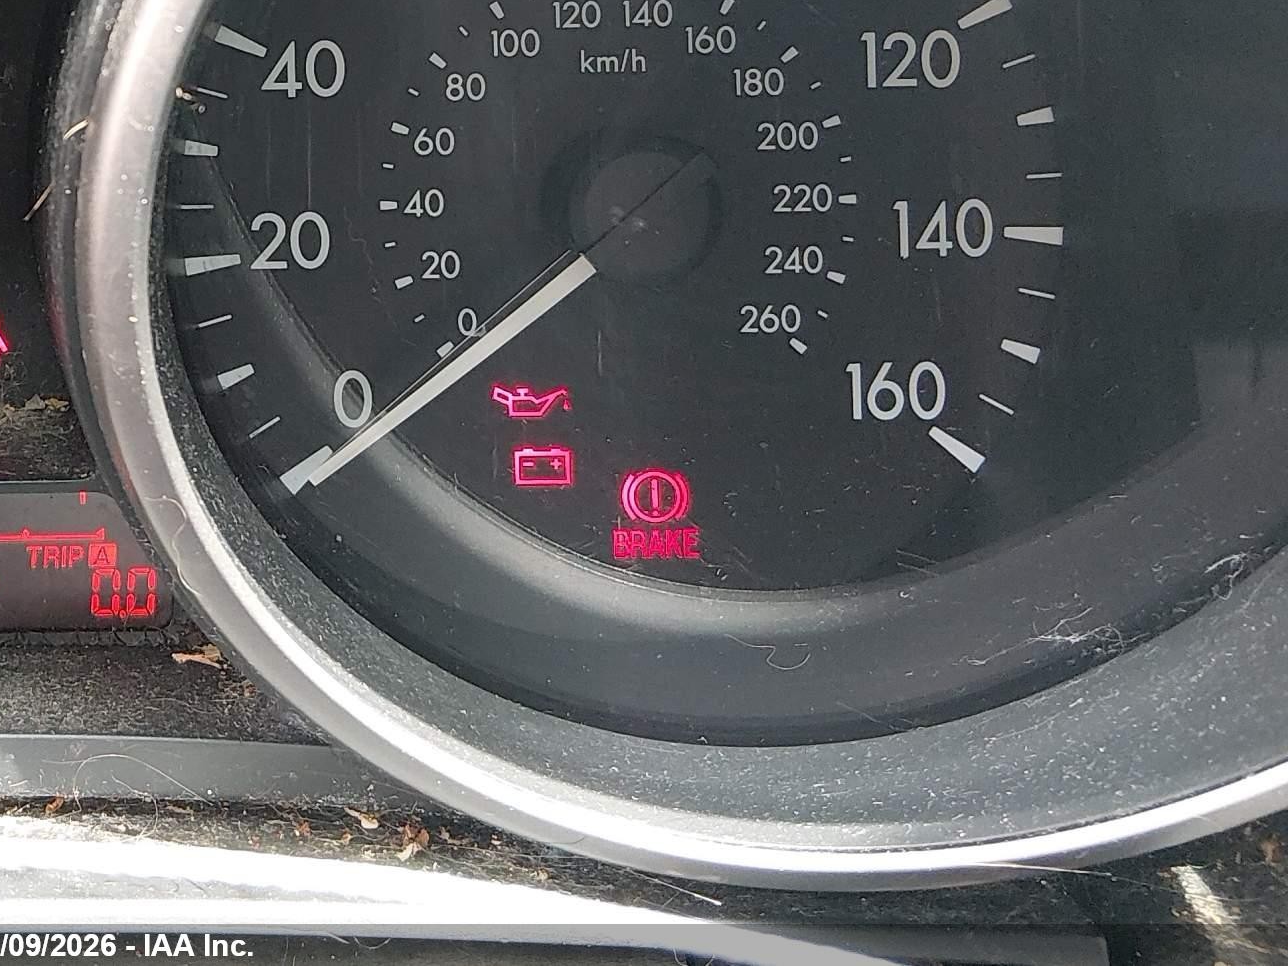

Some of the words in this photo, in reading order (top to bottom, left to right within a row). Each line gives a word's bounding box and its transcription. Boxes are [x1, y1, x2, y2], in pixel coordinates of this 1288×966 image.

[553, 1, 601, 29] 120
[623, 0, 673, 27] 140
[490, 29, 540, 57] 100
[685, 26, 736, 54] 160
[260, 40, 346, 98] 40
[580, 49, 647, 73] km/h
[860, 29, 961, 88] 120
[445, 73, 486, 102] 80
[733, 68, 785, 96] 180
[413, 128, 455, 156] 60
[757, 122, 819, 151] 200
[403, 189, 445, 218] 40
[773, 184, 832, 212] 220
[250, 211, 331, 270] 20
[893, 198, 994, 259] 140
[421, 250, 461, 279] 20
[764, 245, 823, 275] 240
[457, 307, 478, 336] 0
[740, 304, 801, 333] 260
[333, 370, 373, 429] 0
[846, 361, 946, 421] 160
[27, 545, 85, 569] TRIP
[93, 544, 112, 566] A
[612, 530, 700, 559] BRAKE
[90, 567, 157, 618] 0.0
